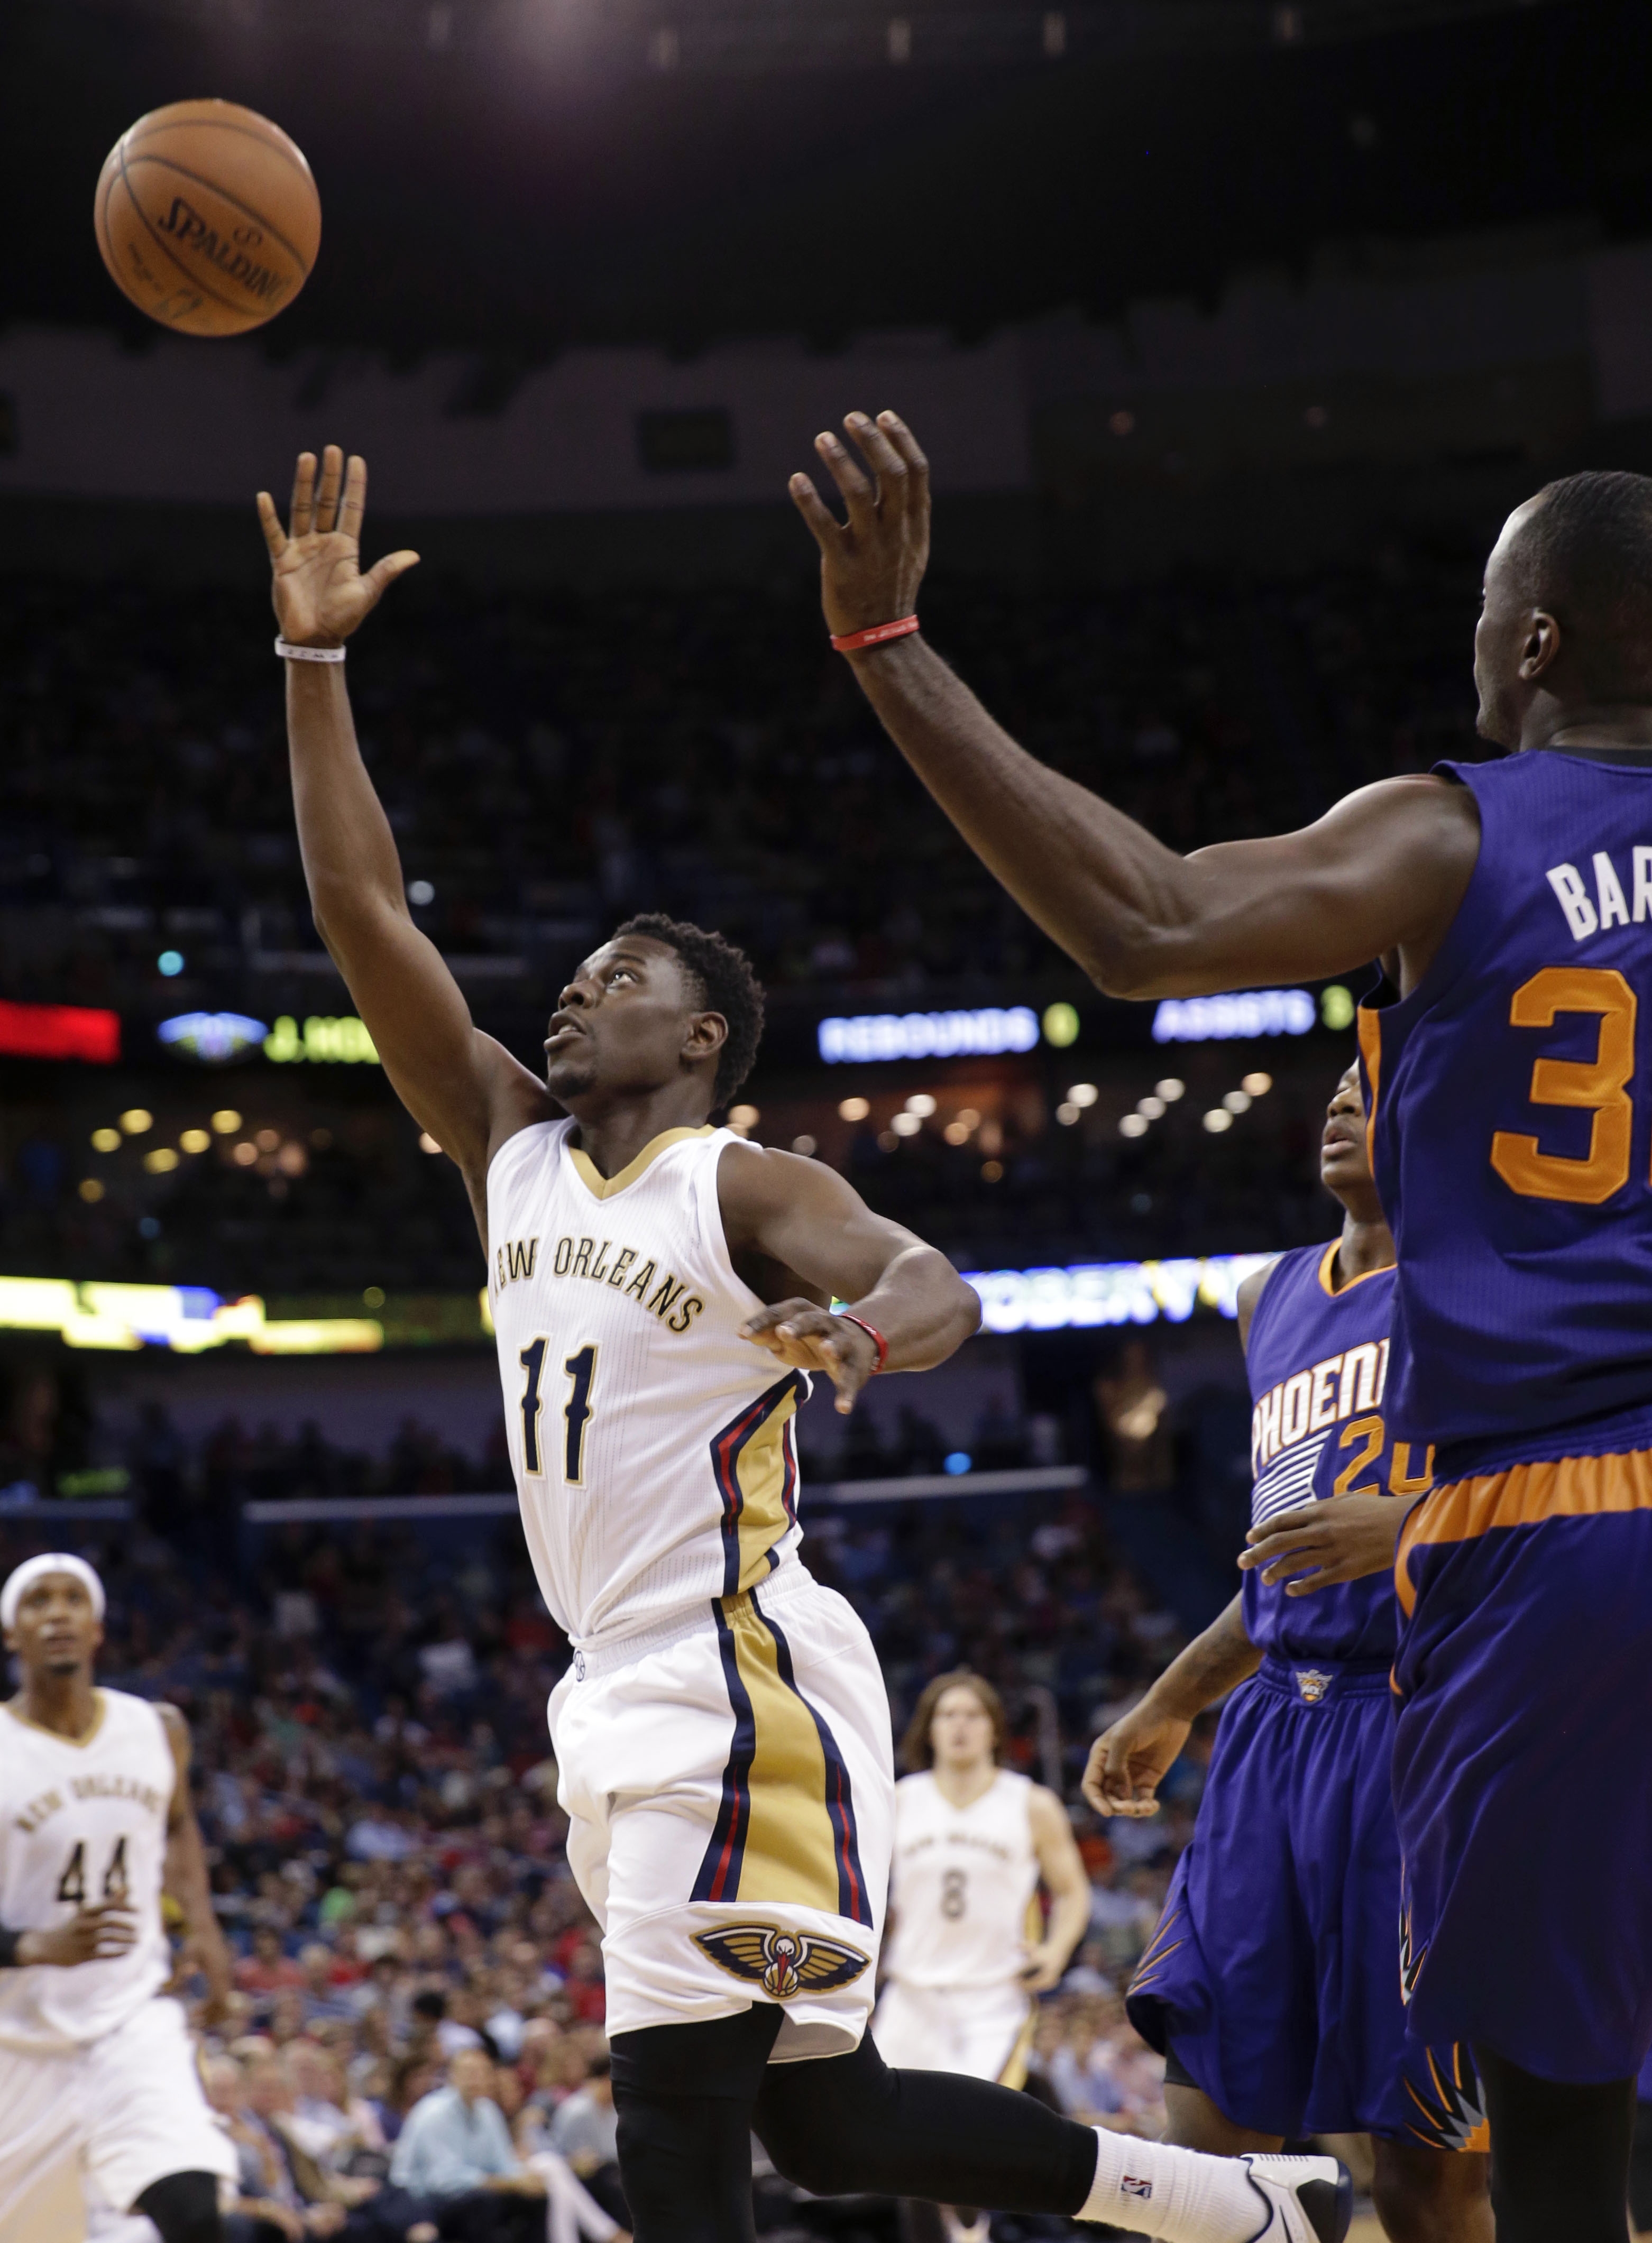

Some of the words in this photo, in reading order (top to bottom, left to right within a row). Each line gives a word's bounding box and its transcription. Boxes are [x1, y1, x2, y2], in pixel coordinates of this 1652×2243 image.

[158, 196, 292, 300] SPALDIN
[1490, 967, 1652, 1205] 3
[553, 1236, 705, 1335] ORLEANS
[519, 1336, 600, 1486] 11
[57, 1834, 129, 1903] 44
